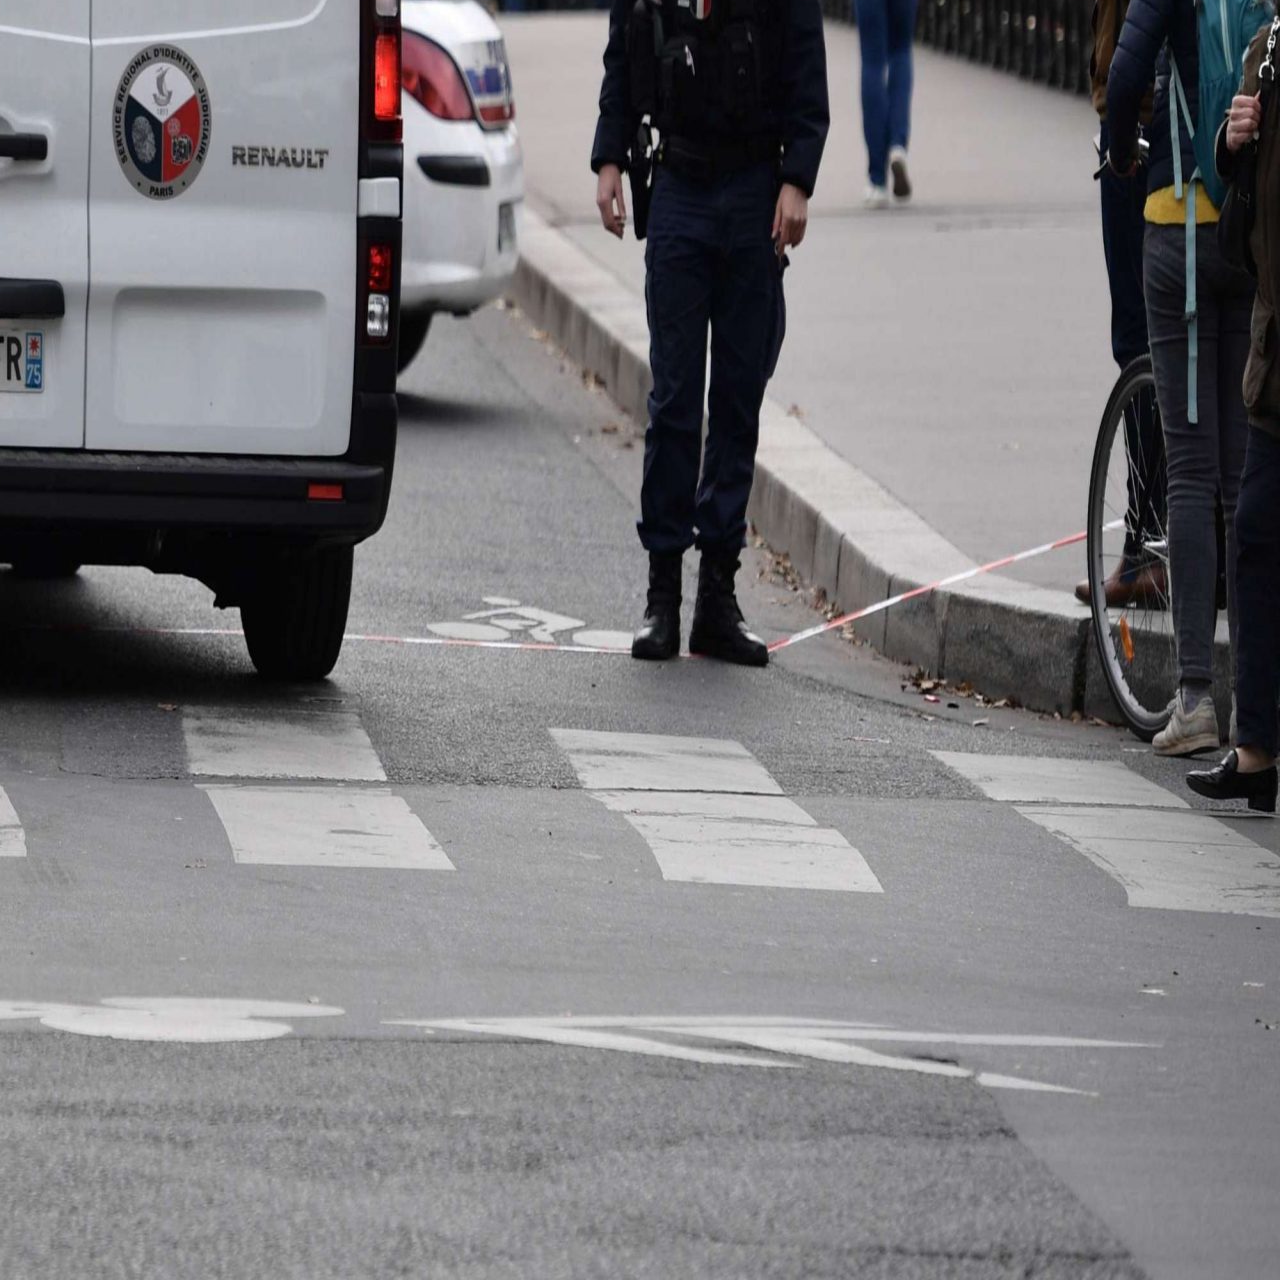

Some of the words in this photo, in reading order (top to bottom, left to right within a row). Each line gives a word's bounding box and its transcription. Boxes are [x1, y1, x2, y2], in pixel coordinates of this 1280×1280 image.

[118, 51, 152, 104] REGIONAL
[153, 47, 200, 82] D'IDENTITE
[114, 108, 128, 165] SERVICE
[196, 87, 210, 164] JUDICIAIRE
[231, 145, 330, 169] RENAULT
[148, 185, 174, 197] PARIS
[26, 363, 42, 385] 75
